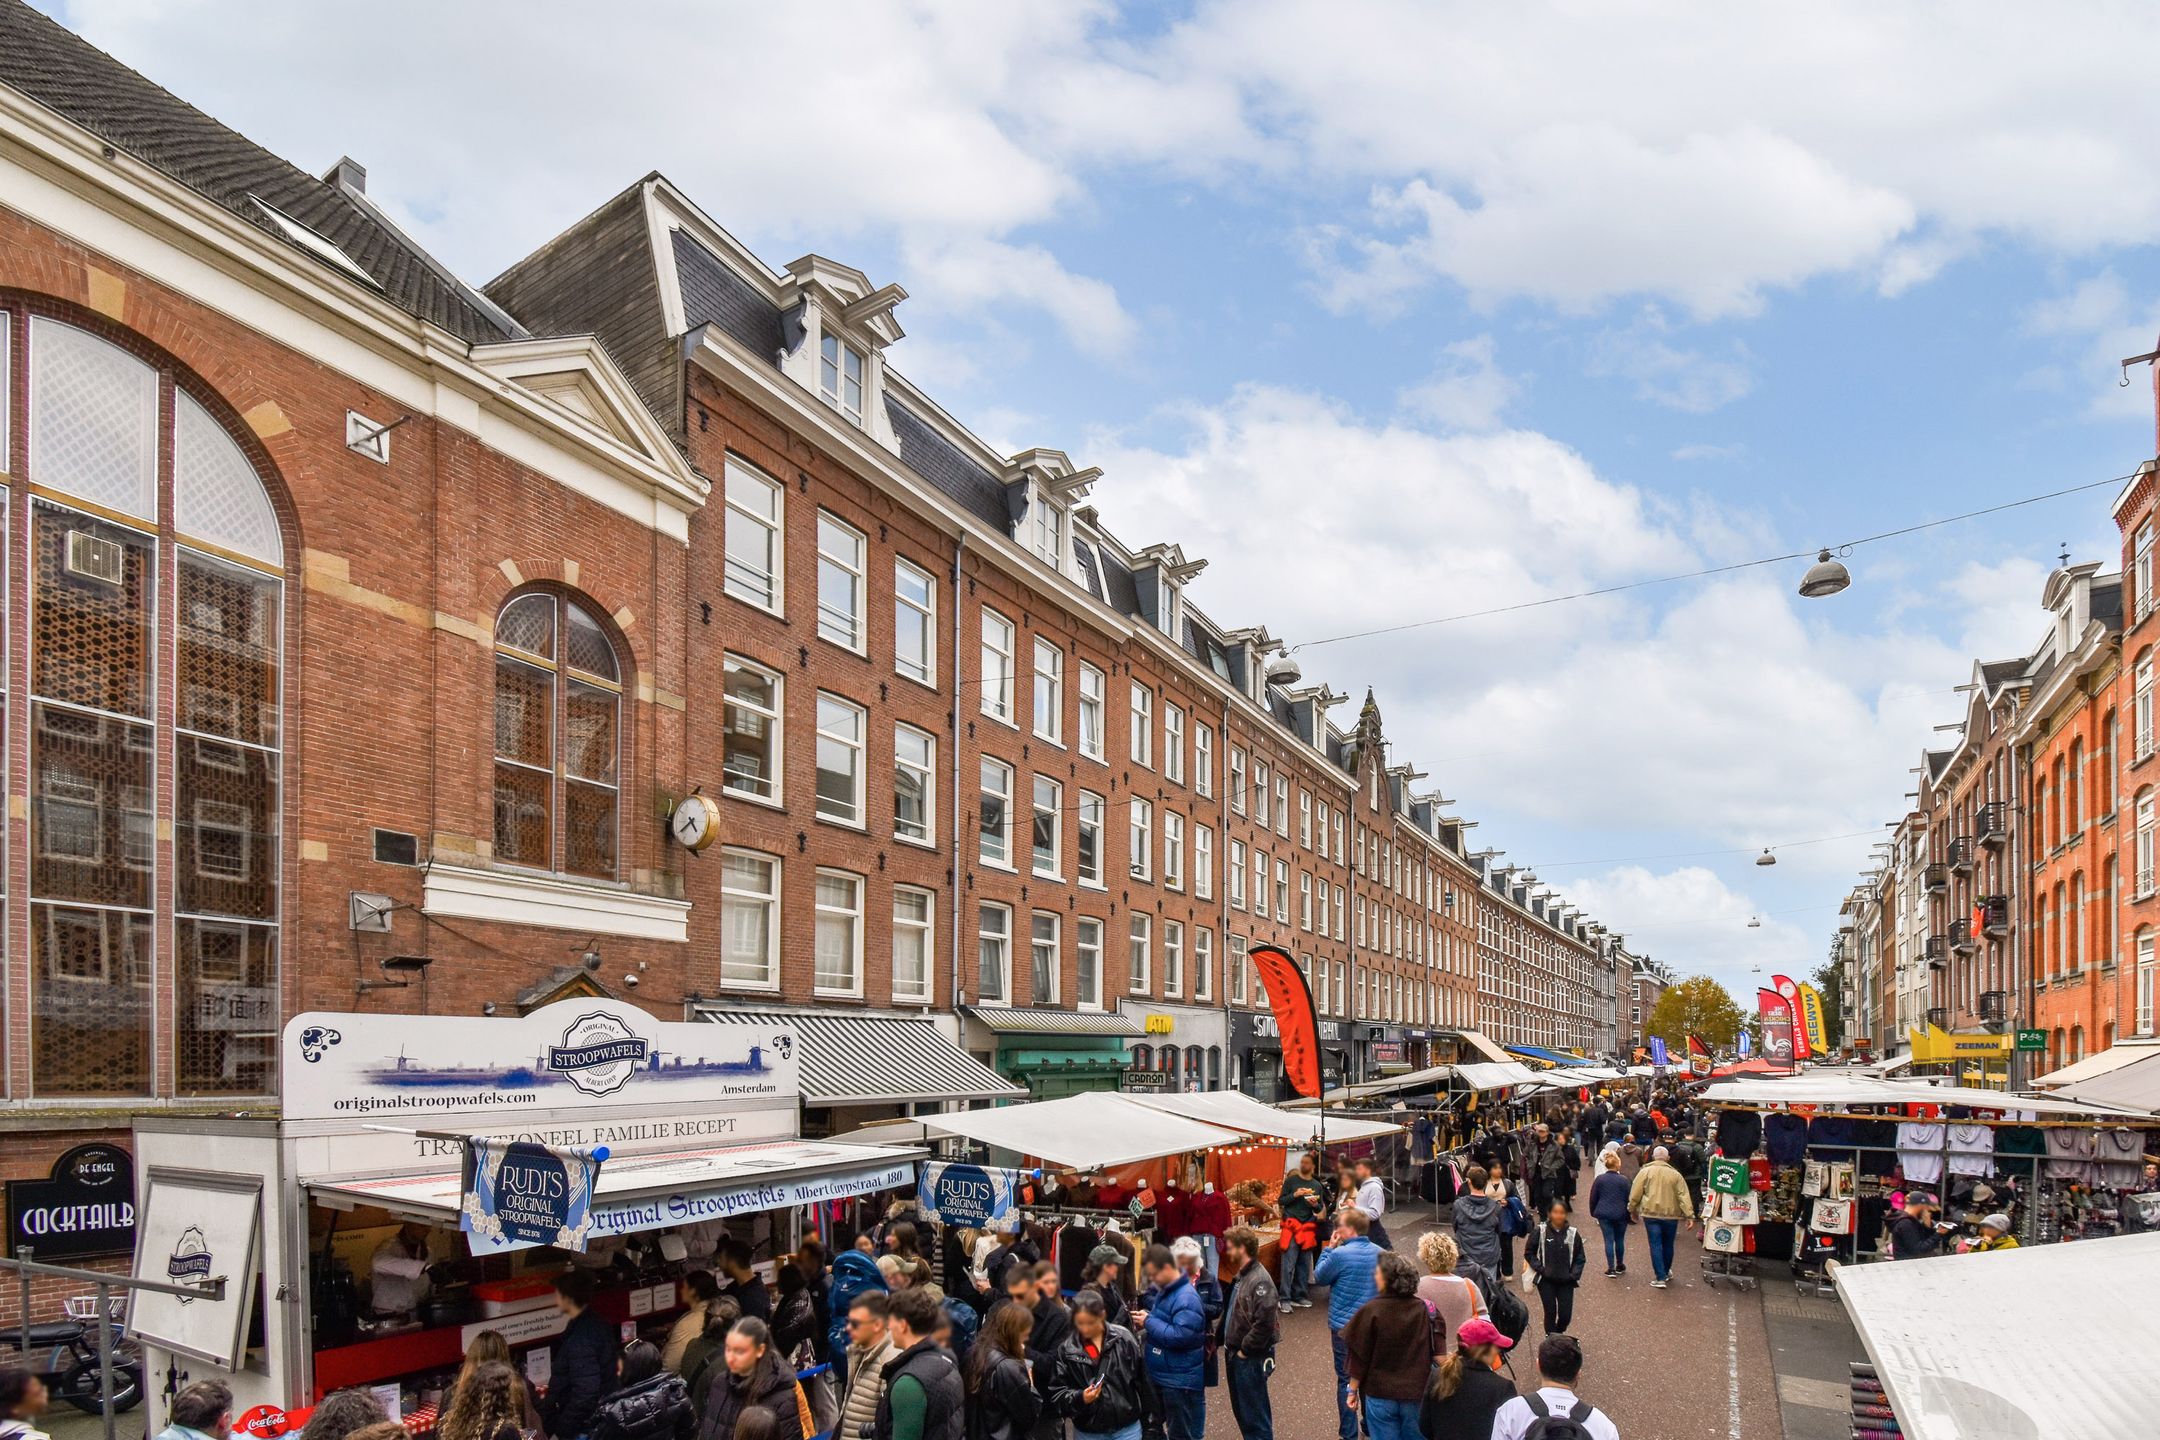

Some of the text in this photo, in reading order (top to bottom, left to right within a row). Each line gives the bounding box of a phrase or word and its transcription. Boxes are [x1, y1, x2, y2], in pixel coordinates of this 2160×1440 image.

[583, 1023, 616, 1033] ORIGINAL
[1150, 1015, 1172, 1034] ATM
[1955, 1042, 1999, 1050] ZEEMAN
[555, 1044, 642, 1066] STROOPWAFELS
[584, 1076, 604, 1086] ALBERT
[721, 1083, 777, 1095] Amsterdam
[334, 1092, 536, 1112] originalstroopwafels.com
[414, 1118, 737, 1157] TRAONEEL FAMILIE RECEPT
[80, 1163, 115, 1173] DE ENGEL
[501, 1166, 563, 1198] RUDI'S
[668, 1186, 786, 1220] Stroopwafels
[887, 1170, 903, 1184] 180
[941, 1179, 990, 1200] RUDI'S
[506, 1195, 555, 1214] ORIGINAL
[945, 1197, 984, 1211] ORIGINAL
[499, 1209, 561, 1229] STROOPWAFELS
[939, 1206, 989, 1219] STROOPWAFELS
[1815, 1237, 1821, 1247] I
[495, 1324, 507, 1332] real
[524, 1318, 545, 1326] freshly
[523, 1324, 552, 1336] gebakken
